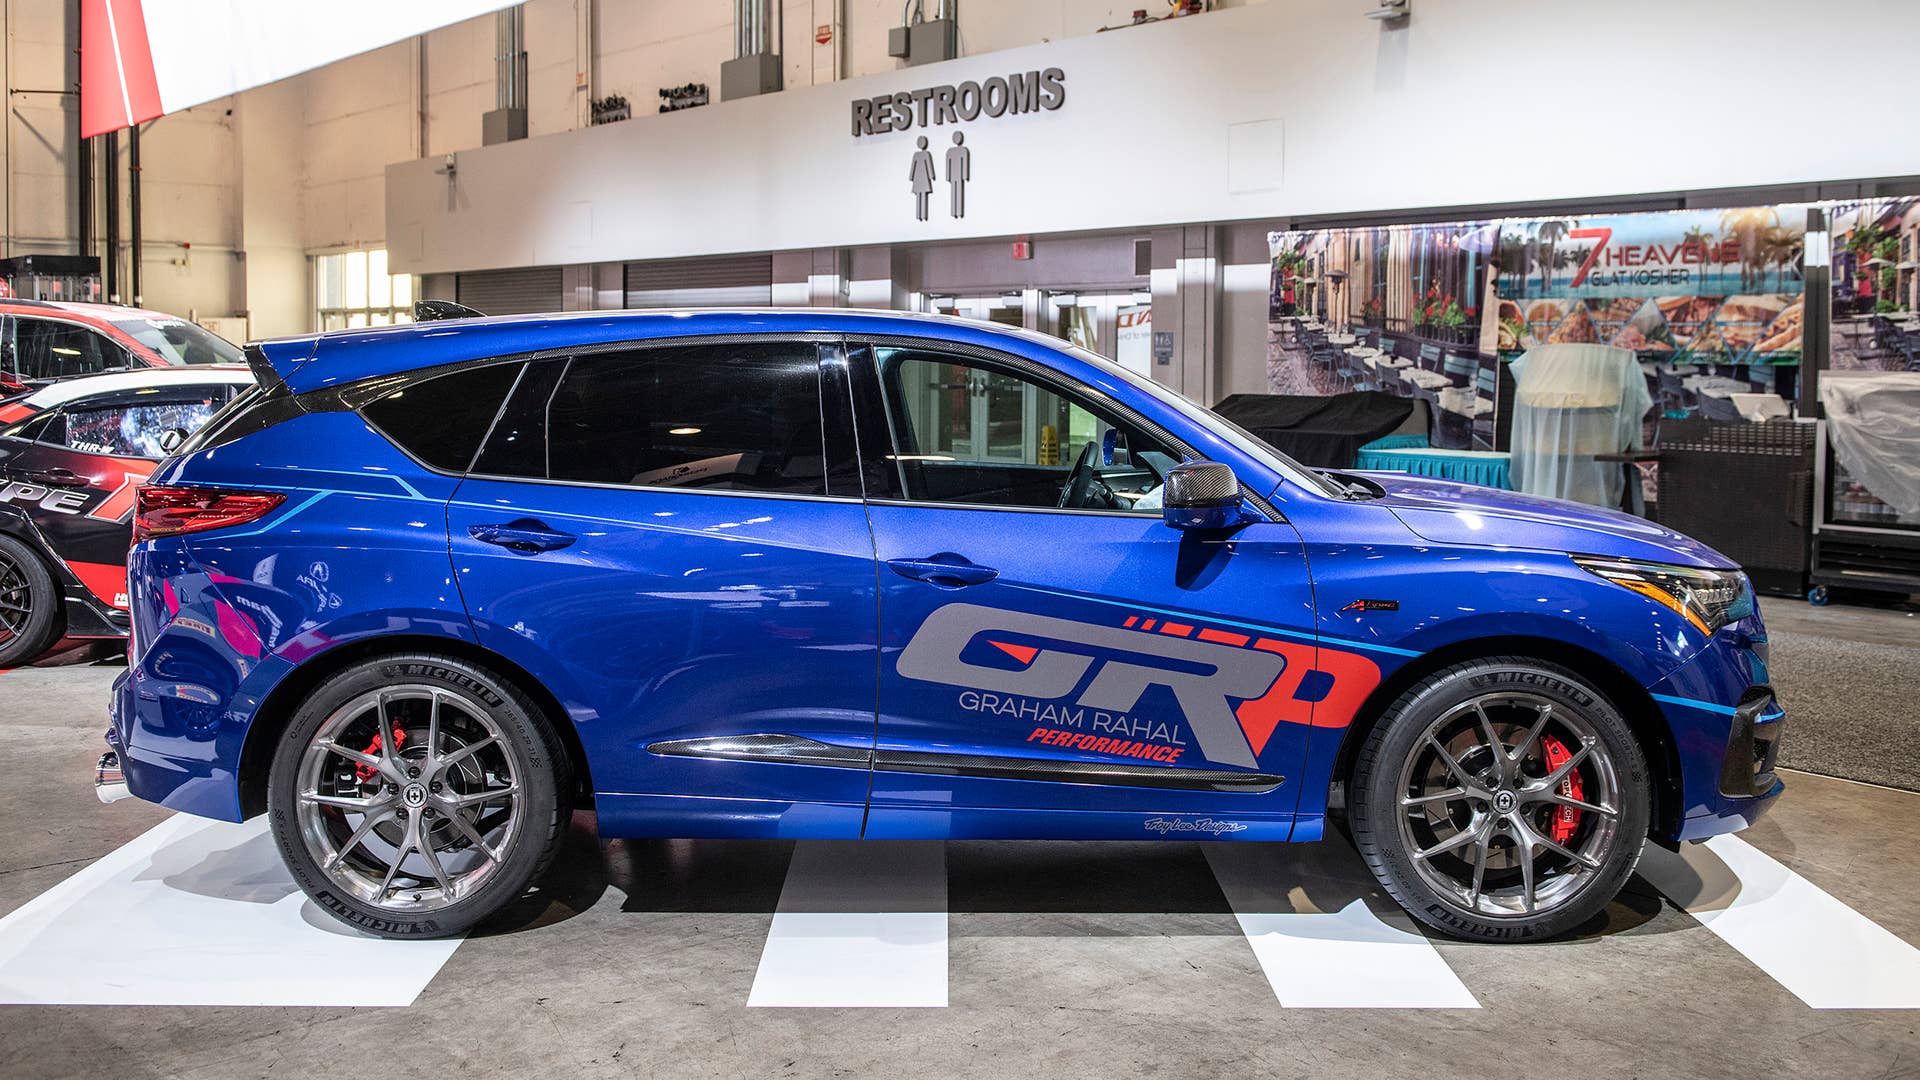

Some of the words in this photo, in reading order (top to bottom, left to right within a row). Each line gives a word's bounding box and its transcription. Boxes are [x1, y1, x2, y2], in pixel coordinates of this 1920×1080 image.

[851, 67, 1065, 137] RESTROOMS
[1570, 227, 1612, 288] 7
[1606, 242, 1742, 267] HEAVENS
[1591, 272, 1627, 287] GLAT
[1630, 269, 1690, 286] KOSHER
[408, 664, 500, 703] MICHELIN
[896, 602, 1382, 769] GRP
[1498, 671, 1590, 704] MICHELIN
[958, 691, 1084, 728] GRAHAM
[1092, 711, 1187, 745] RAHAL
[1027, 727, 1185, 764] PERFORMANCE
[1144, 817, 1171, 835] Troy
[1170, 817, 1194, 832] Lee
[1195, 818, 1247, 836] Designs
[319, 892, 412, 933] MICHELIN
